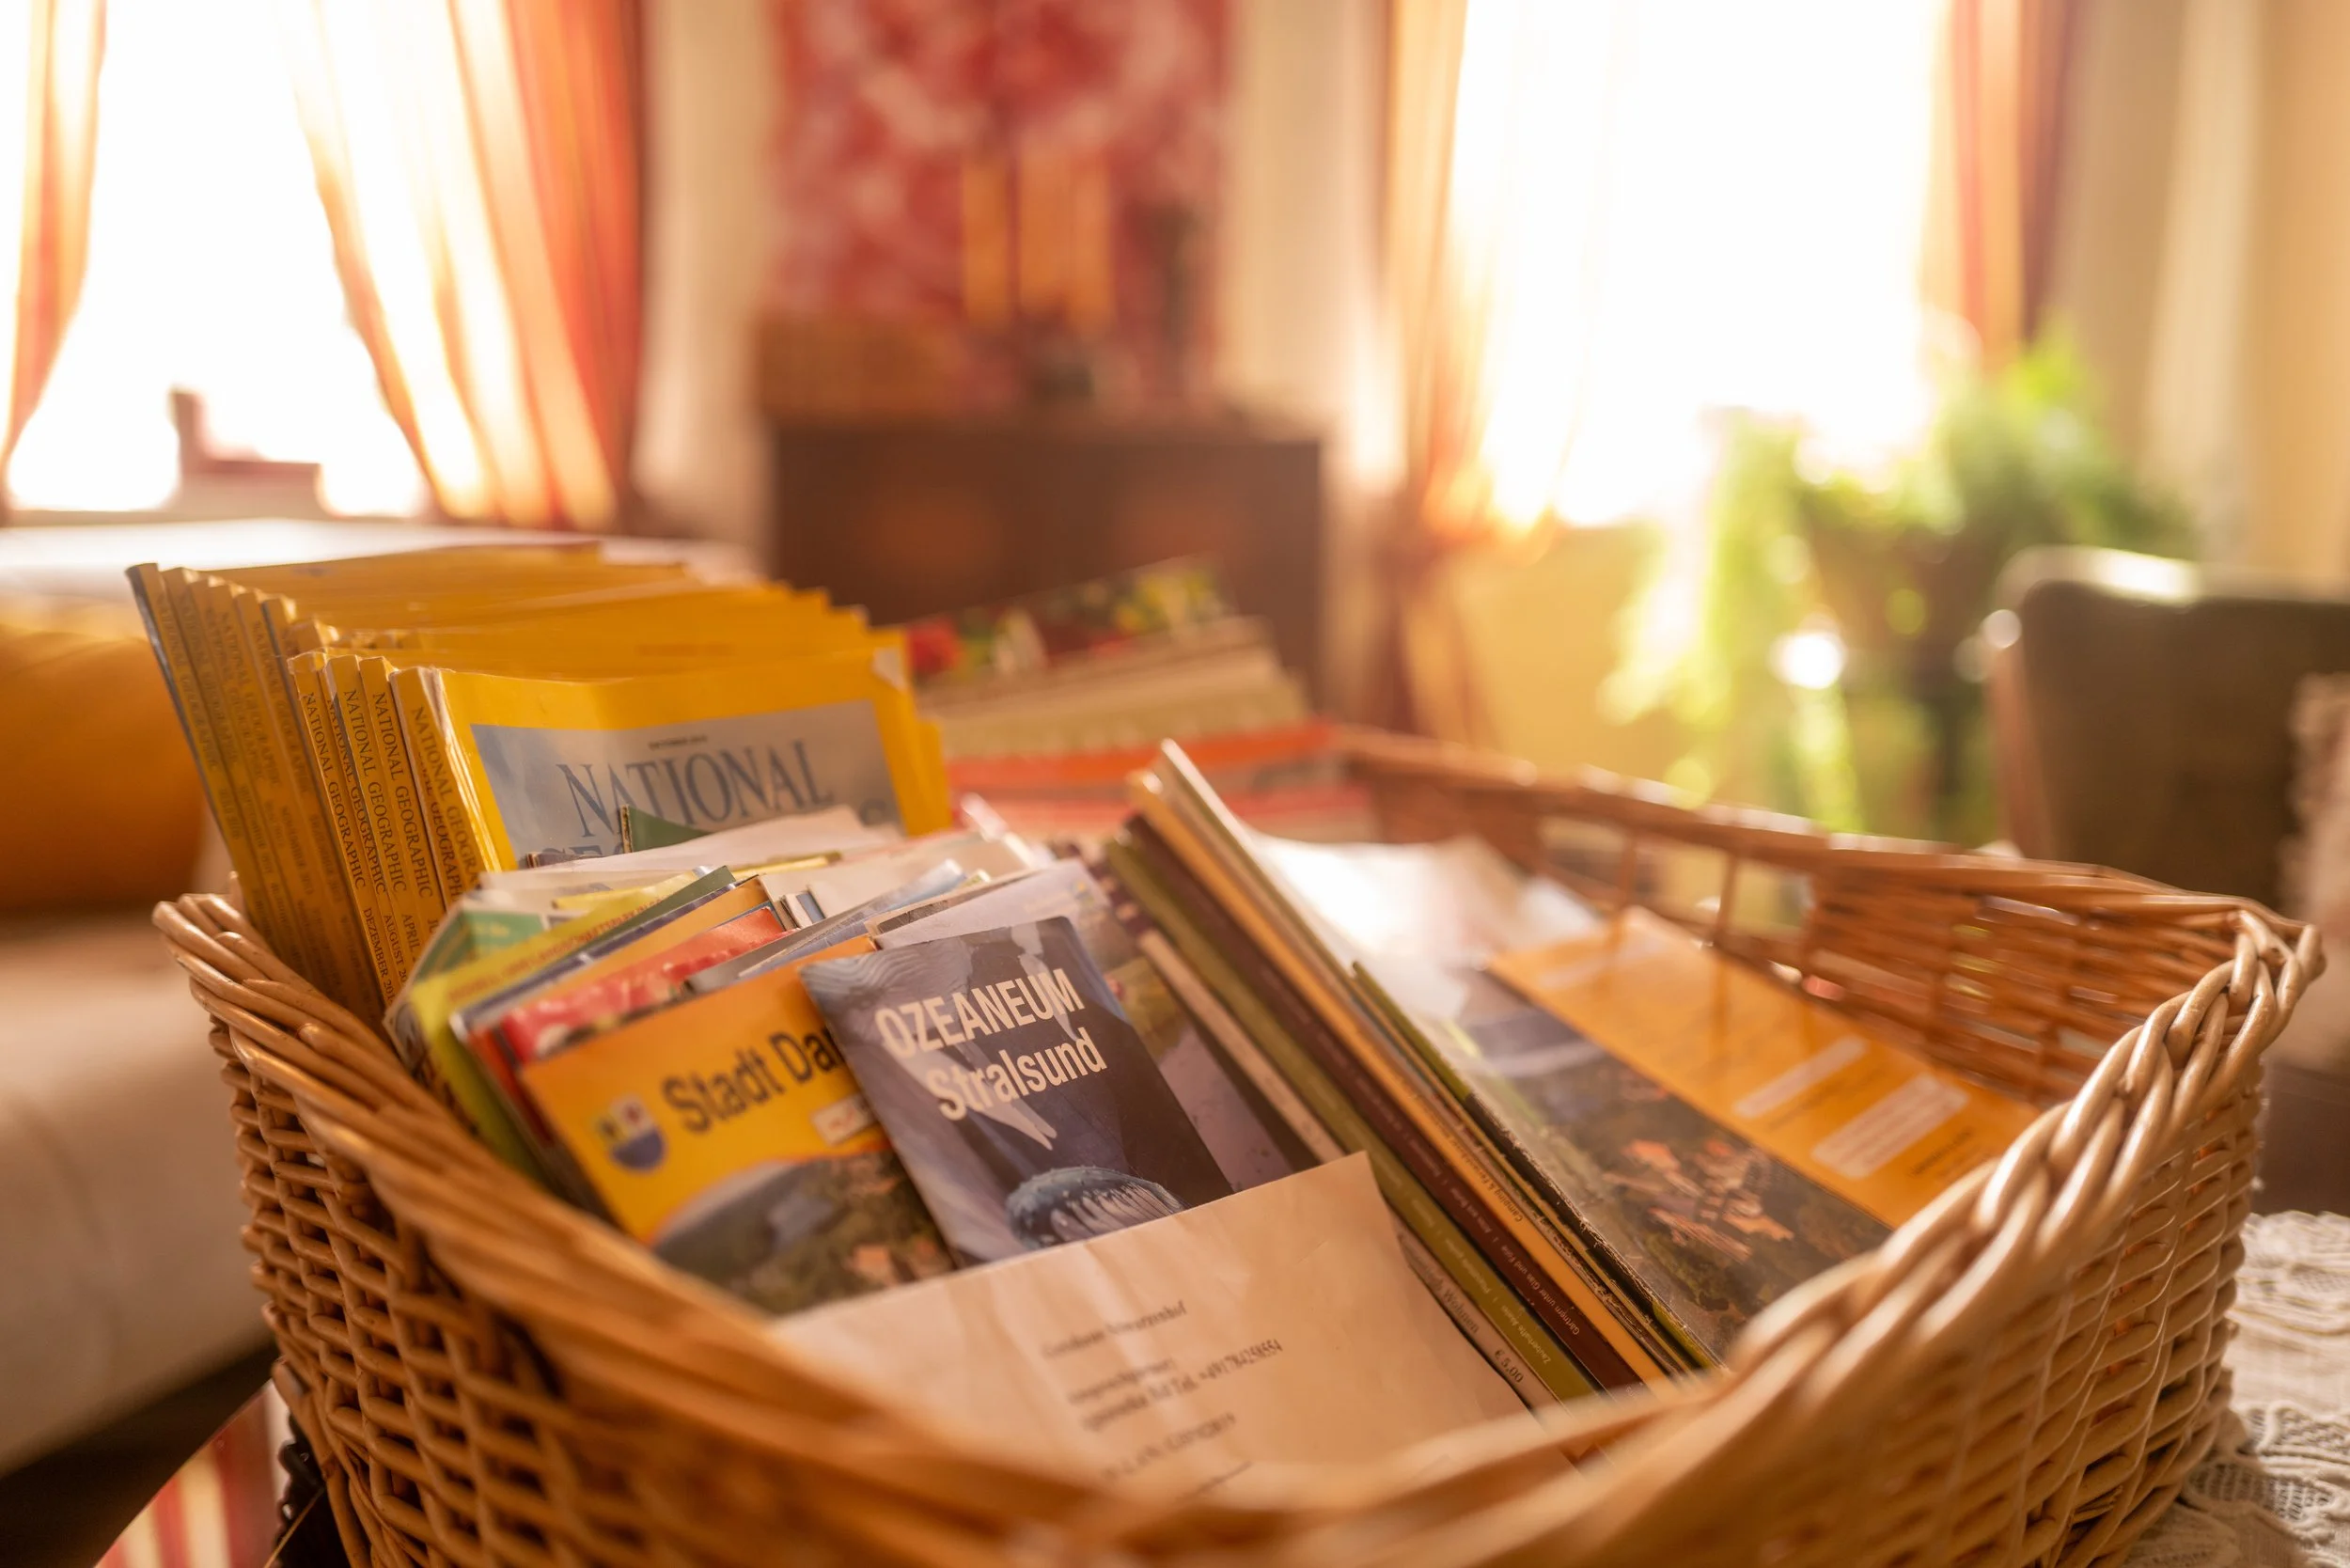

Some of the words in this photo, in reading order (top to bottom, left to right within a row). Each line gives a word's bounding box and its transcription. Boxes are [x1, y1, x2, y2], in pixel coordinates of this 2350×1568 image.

[372, 691, 404, 781] NATIONAL
[395, 785, 433, 899] GEOGRAPHIC
[414, 705, 453, 802] NATIONAL
[556, 738, 836, 839] NATIONAL
[303, 692, 335, 778] NATIONAL
[328, 781, 367, 890] GEOGRAPHIC
[363, 907, 389, 978] DEZEMBER
[383, 979, 395, 1004] 201
[344, 688, 377, 777] NATIONAL
[368, 781, 407, 892] GEOGRAPHIC
[401, 914, 421, 951] APRIL
[350, 783, 387, 896] GEOGRAPHIC
[384, 914, 405, 965] AUGUST
[874, 966, 1086, 1059] OZEANEUM
[662, 1047, 787, 1133] Stadt
[924, 1027, 1108, 1121] Stralsund
[1495, 1187, 1523, 1223] Camping
